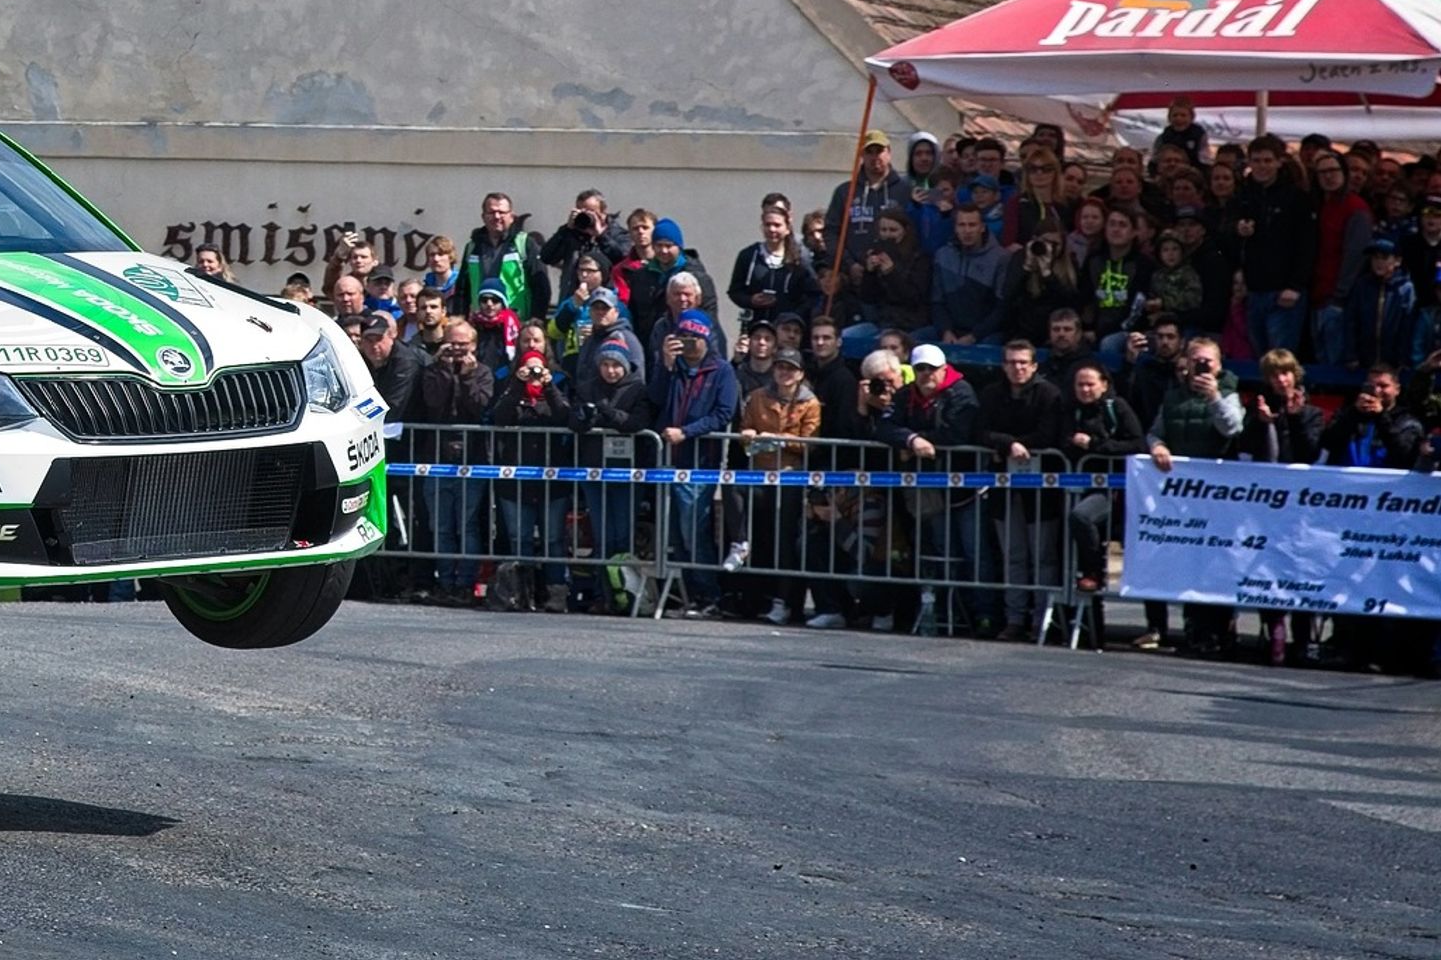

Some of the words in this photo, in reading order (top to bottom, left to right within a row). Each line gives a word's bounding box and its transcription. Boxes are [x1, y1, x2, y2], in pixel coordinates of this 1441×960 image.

[44, 347, 103, 362] 0369
[347, 431, 380, 472] ŠKODA
[1161, 477, 1289, 509] HHracing
[1298, 487, 1368, 510] team
[1375, 491, 1441, 516] fand
[1241, 535, 1267, 550] 42
[1363, 597, 1389, 614] 91
